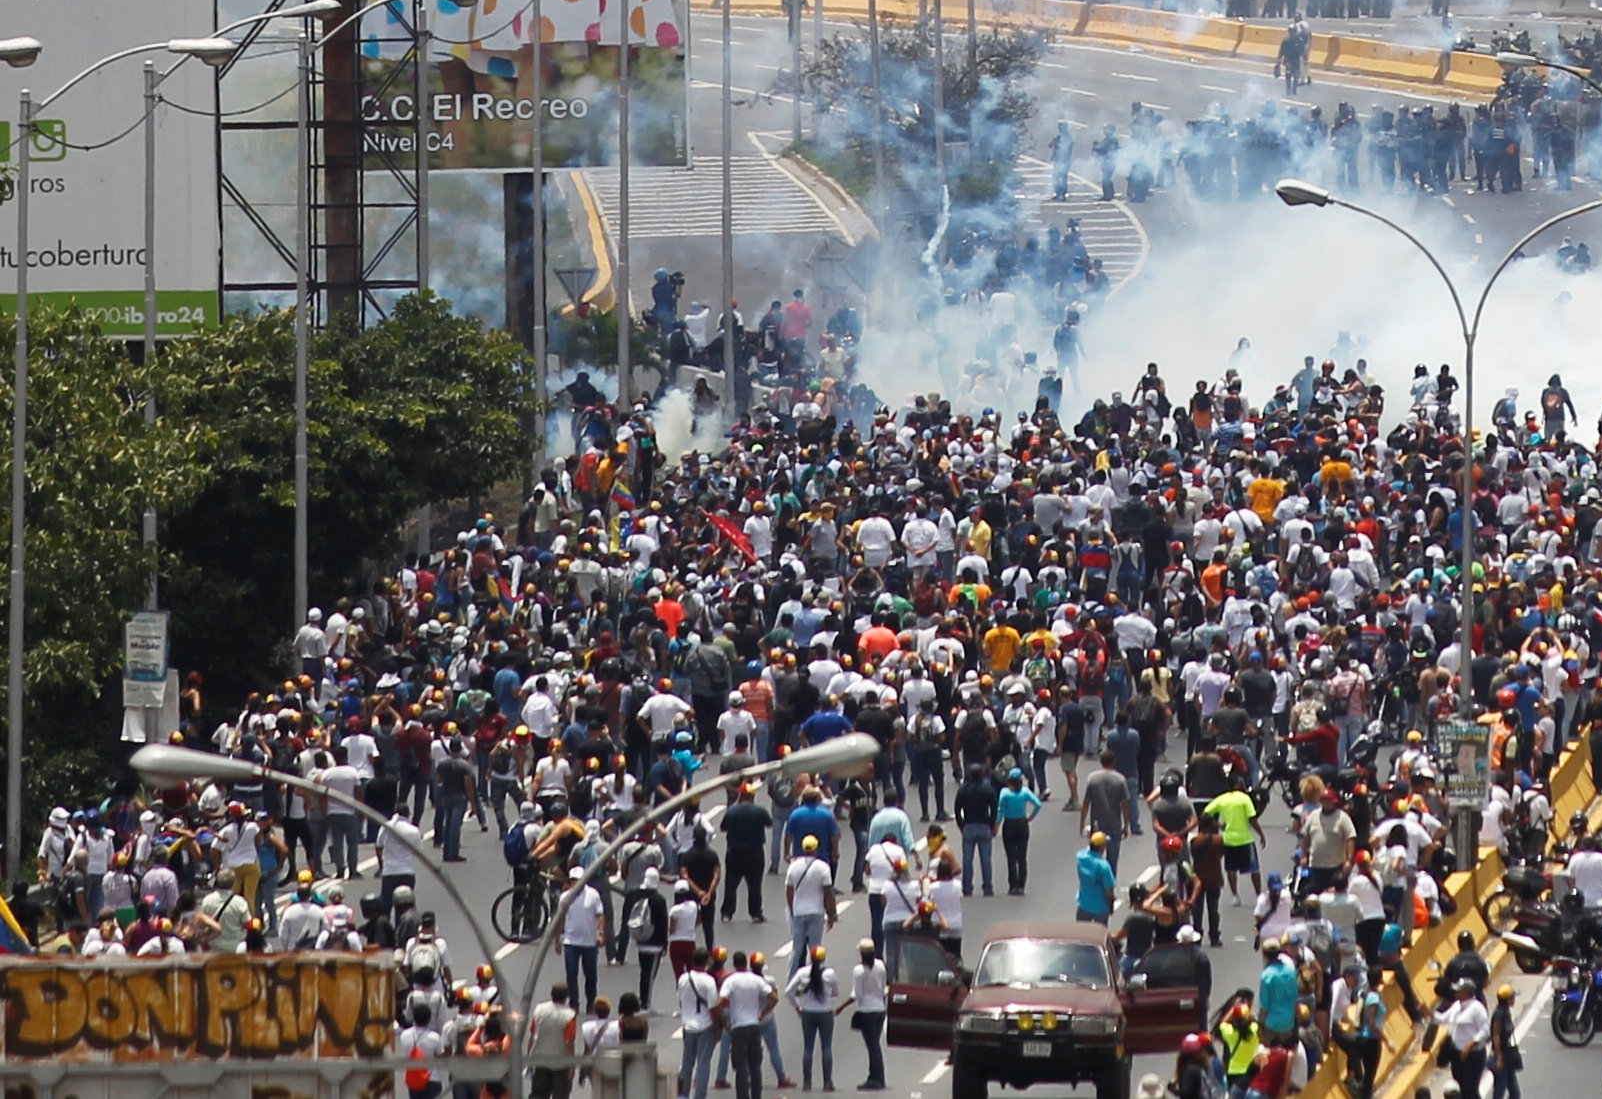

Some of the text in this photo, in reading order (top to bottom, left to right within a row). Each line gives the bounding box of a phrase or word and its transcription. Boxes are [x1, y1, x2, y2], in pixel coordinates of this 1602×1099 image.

[433, 93, 461, 120] El
[473, 92, 588, 120] Recreo
[425, 132, 454, 151] C4
[6, 967, 197, 1047] DON
